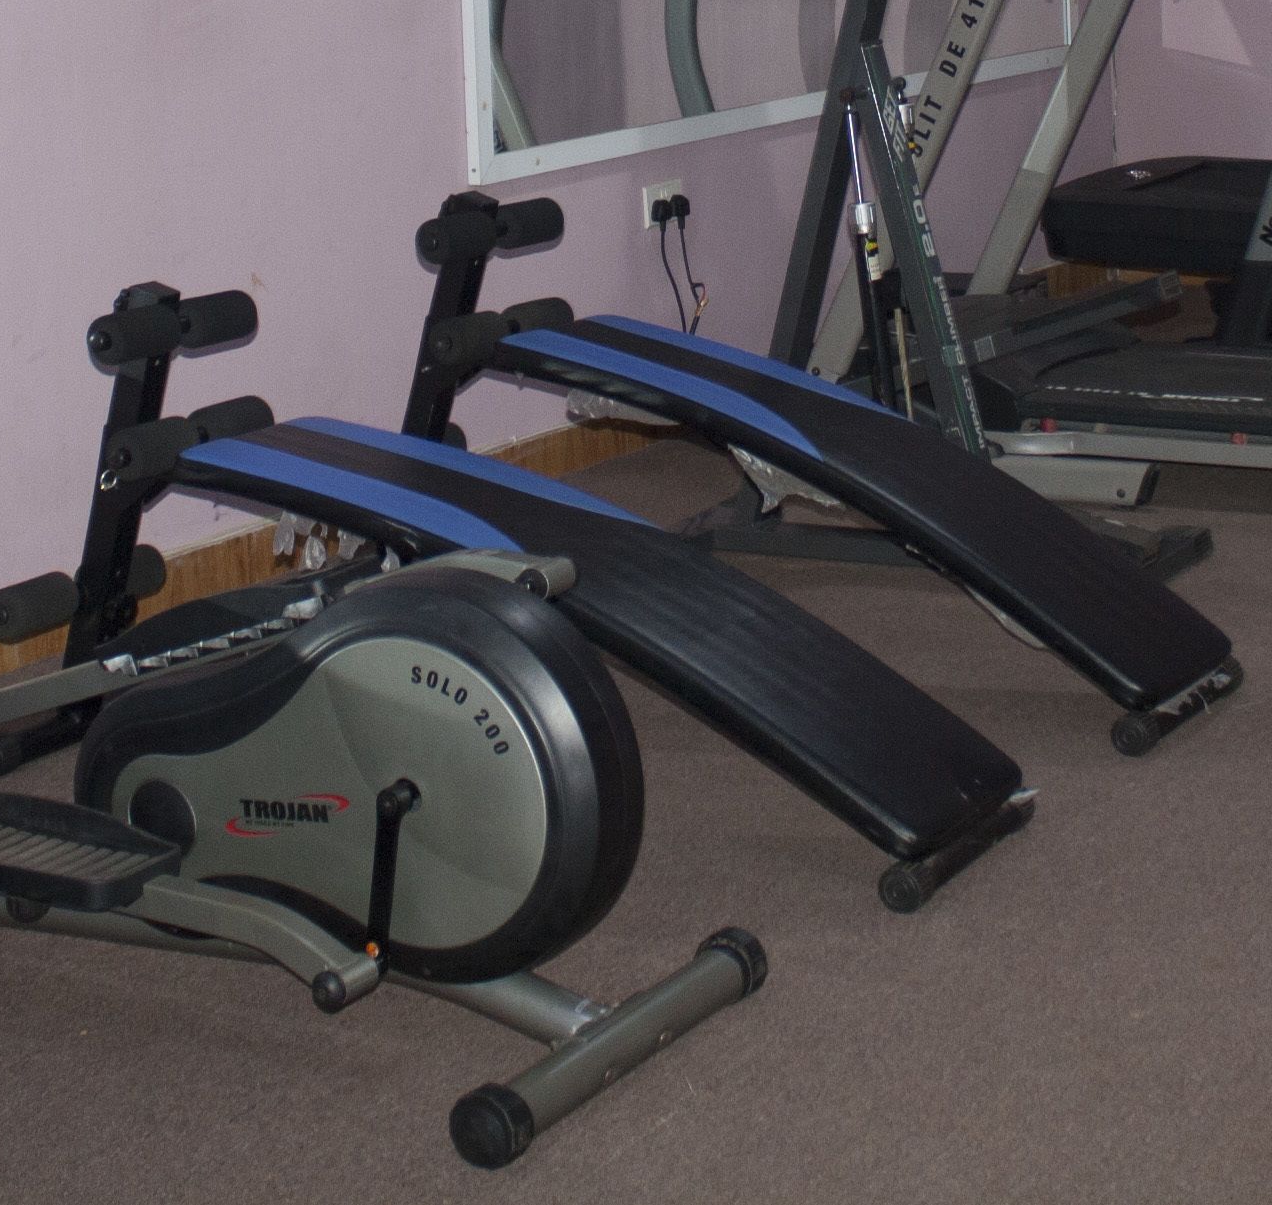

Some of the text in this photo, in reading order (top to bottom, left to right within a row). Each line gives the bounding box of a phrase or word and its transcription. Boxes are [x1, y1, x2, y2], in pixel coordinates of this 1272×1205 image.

[938, 40, 967, 78] DE
[912, 198, 937, 258] 2.0
[410, 665, 510, 755] SOLO 200
[238, 798, 330, 824] TROJAN
